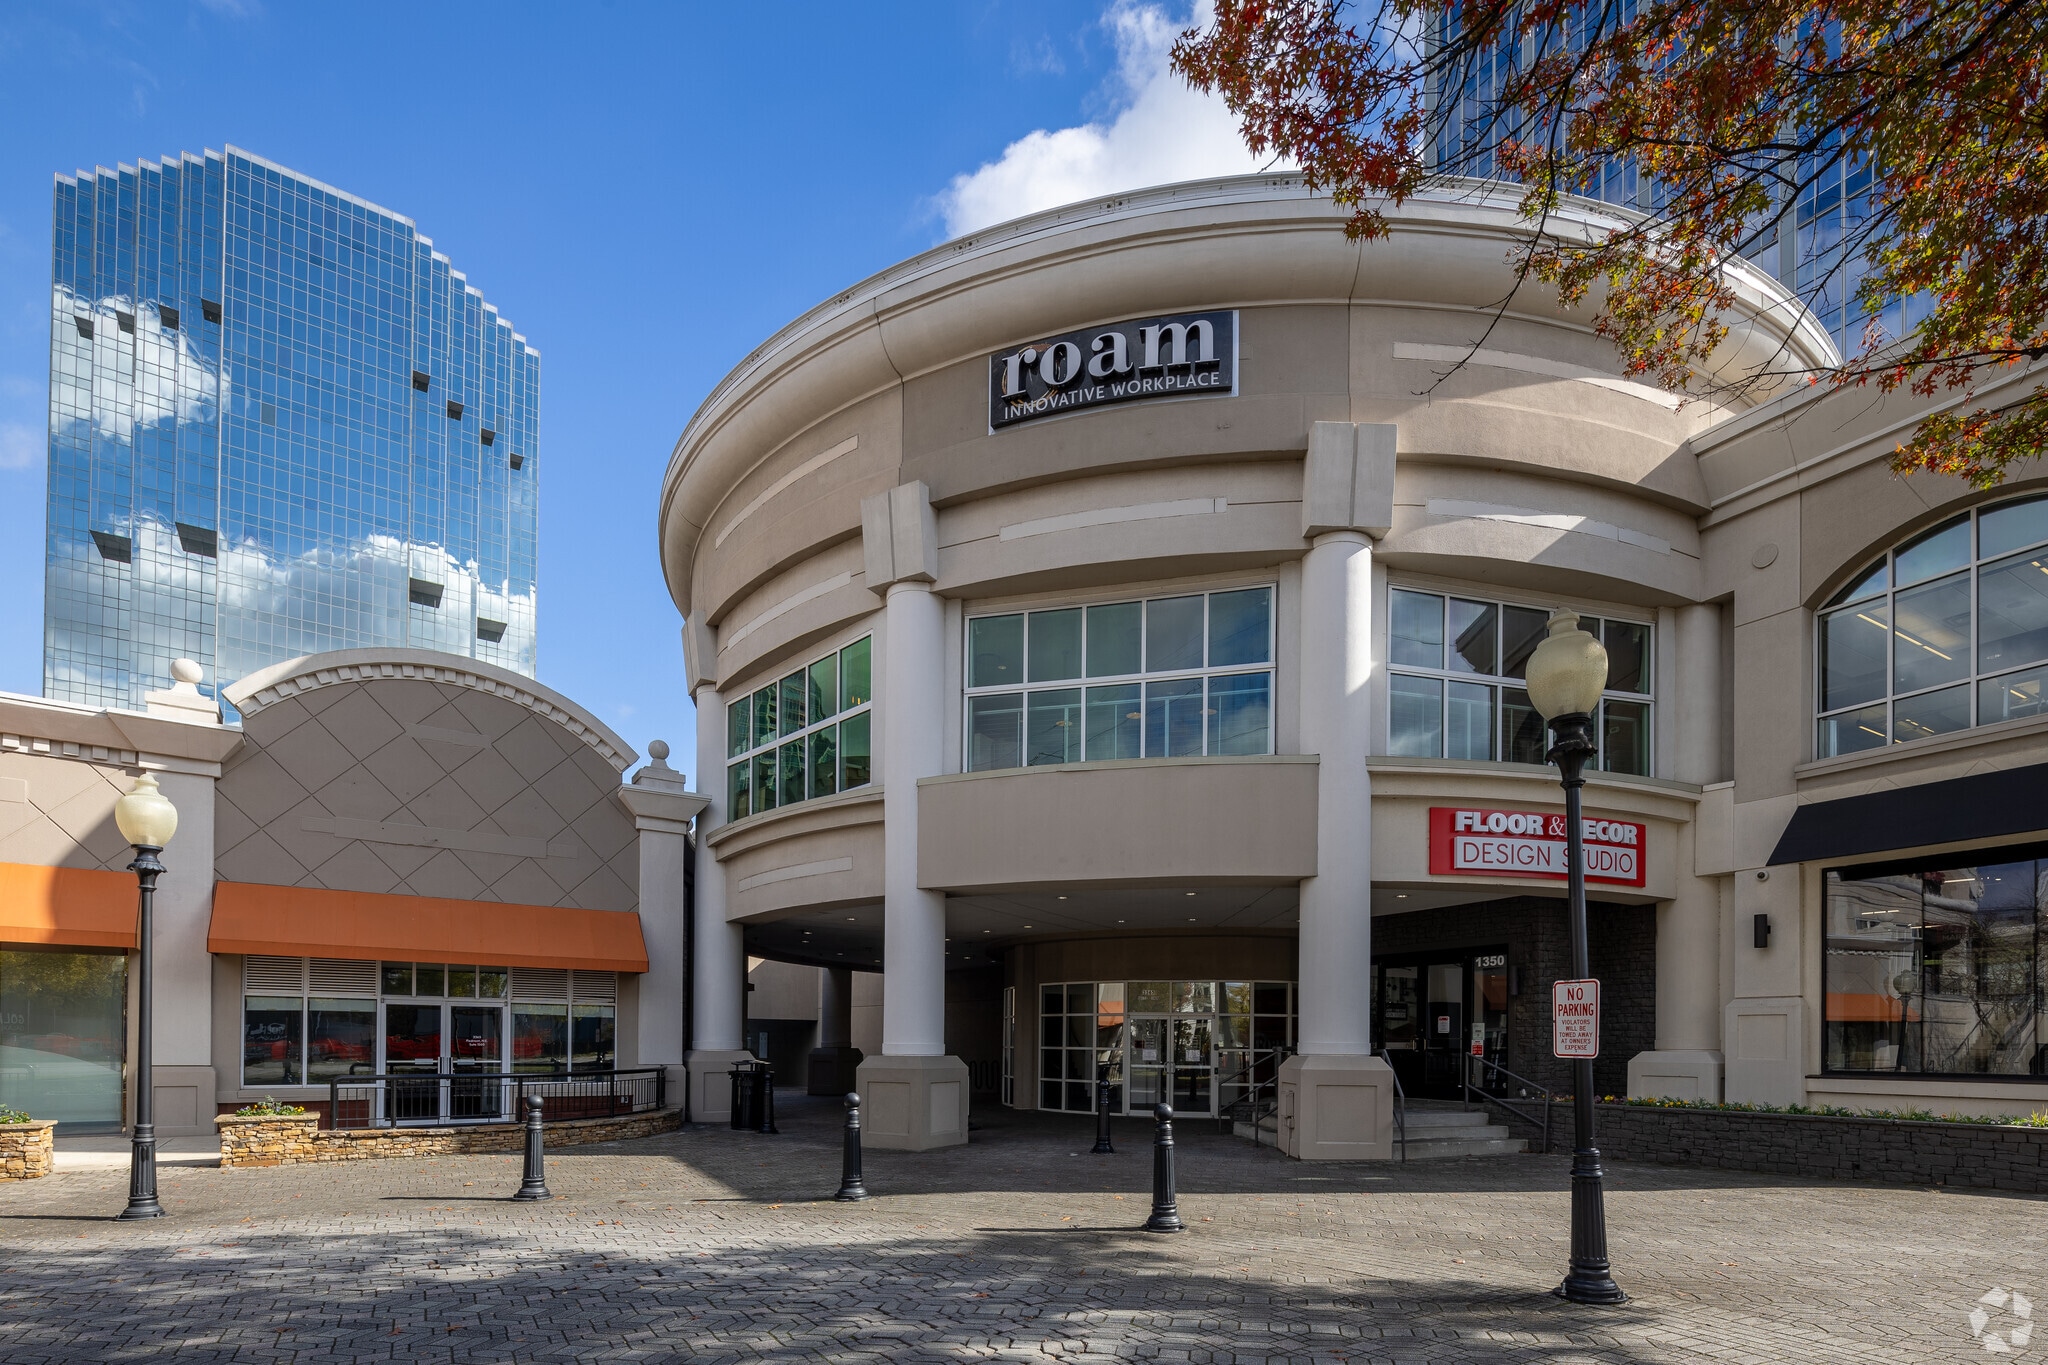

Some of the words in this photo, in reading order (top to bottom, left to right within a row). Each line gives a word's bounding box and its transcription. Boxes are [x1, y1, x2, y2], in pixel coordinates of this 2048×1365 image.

[1001, 319, 1220, 398] roam
[1004, 385, 1105, 420] INNOVATIVE
[1111, 371, 1220, 397] WORKPLACE
[1454, 810, 1544, 836] FLOOR
[1548, 816, 1565, 837] &
[1565, 818, 1637, 845] ECOR
[1463, 841, 1551, 867] DESIGN
[1562, 847, 1633, 873] SUDIO
[1475, 955, 1505, 967] 1350
[1558, 1003, 1594, 1016] PARKING
[1567, 987, 1583, 1000] NO
